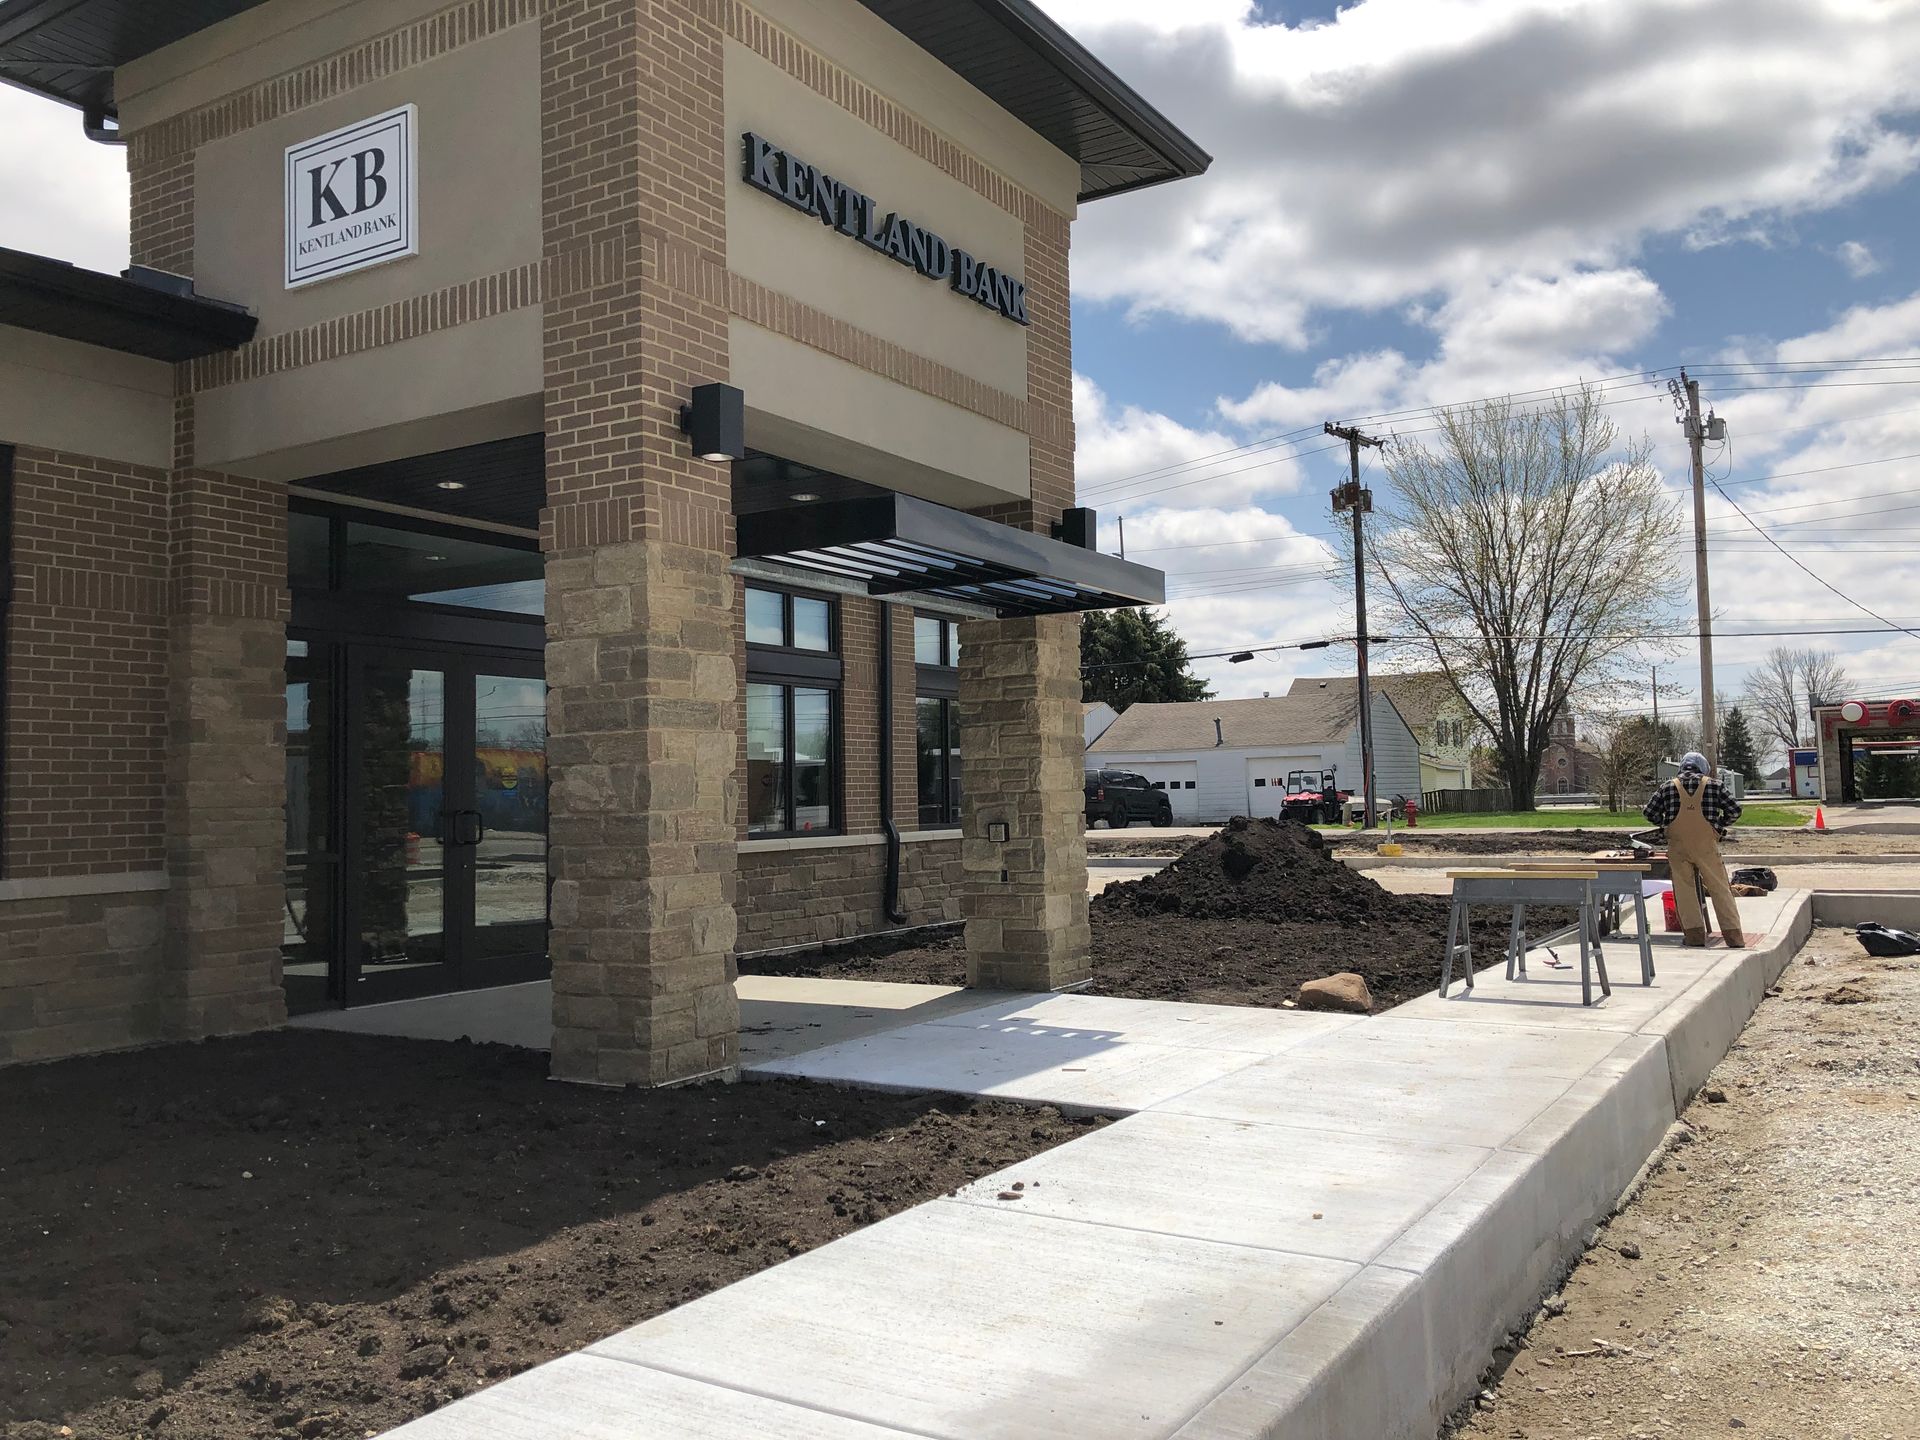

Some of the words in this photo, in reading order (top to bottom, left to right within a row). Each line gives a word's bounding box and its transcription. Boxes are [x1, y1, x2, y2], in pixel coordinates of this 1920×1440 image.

[307, 148, 387, 228] KB
[298, 223, 363, 256] KENTLAND
[364, 213, 397, 237] BANK
[742, 131, 950, 280] KENTLAND
[950, 248, 1029, 326] BANK
